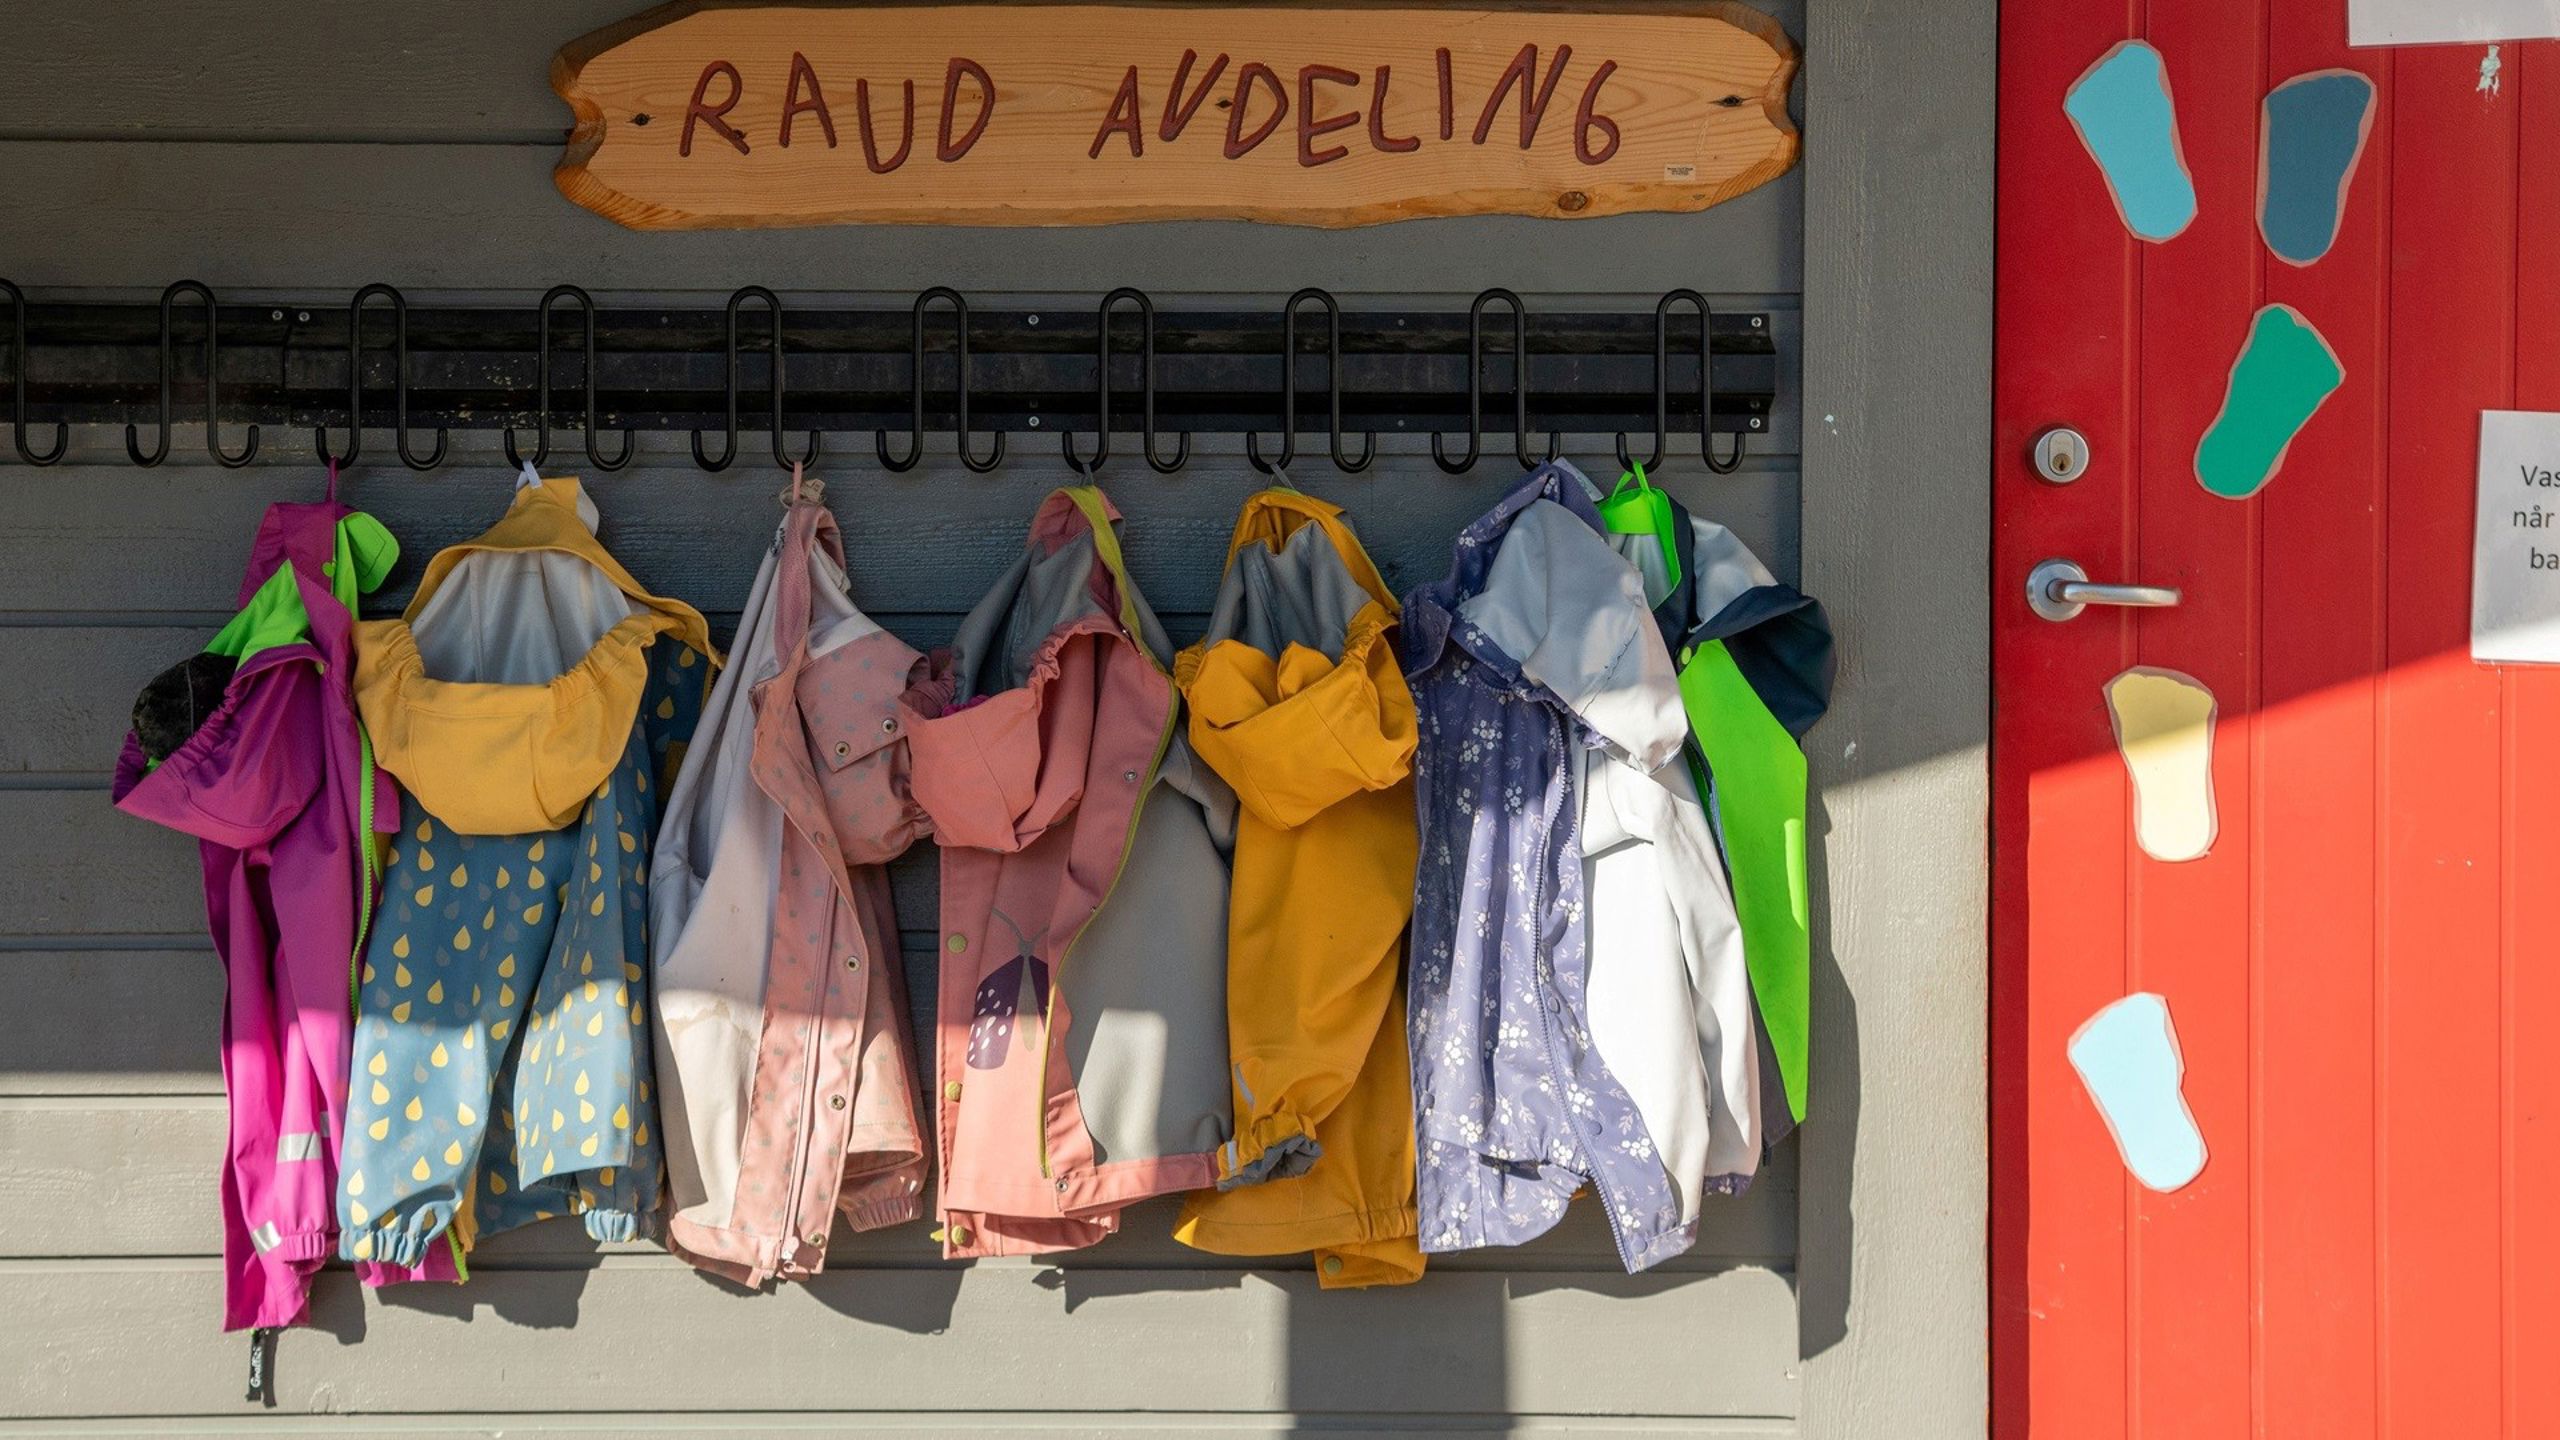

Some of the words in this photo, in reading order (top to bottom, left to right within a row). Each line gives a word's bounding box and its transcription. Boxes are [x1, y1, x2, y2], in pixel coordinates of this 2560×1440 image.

[679, 51, 996, 174] RAUD
[1089, 43, 1620, 167] AVDELING
[2513, 504, 2555, 528] når
[2530, 546, 2560, 570] ba
